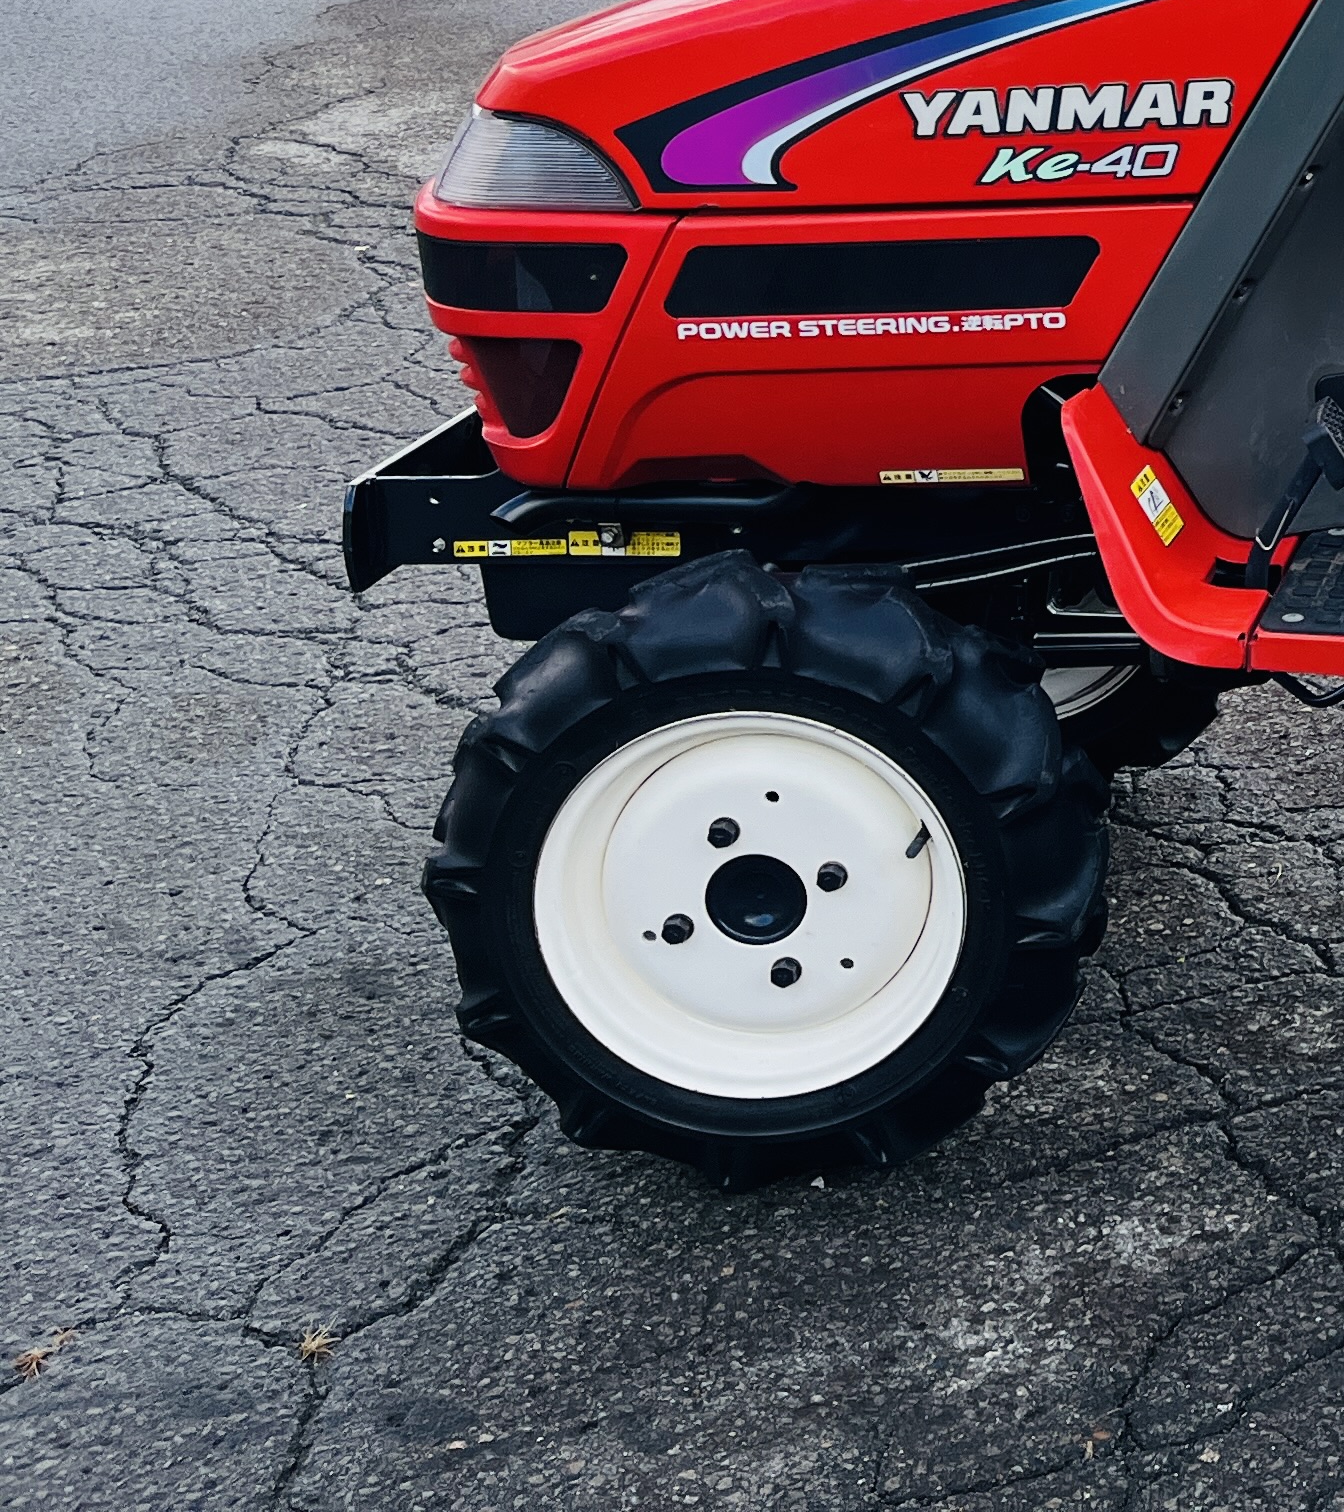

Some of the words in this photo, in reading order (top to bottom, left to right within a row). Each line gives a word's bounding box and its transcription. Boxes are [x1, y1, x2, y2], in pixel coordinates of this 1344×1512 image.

[902, 79, 1233, 137] YANMAR
[978, 142, 1179, 184] Ke-40
[676, 320, 792, 340] POWER
